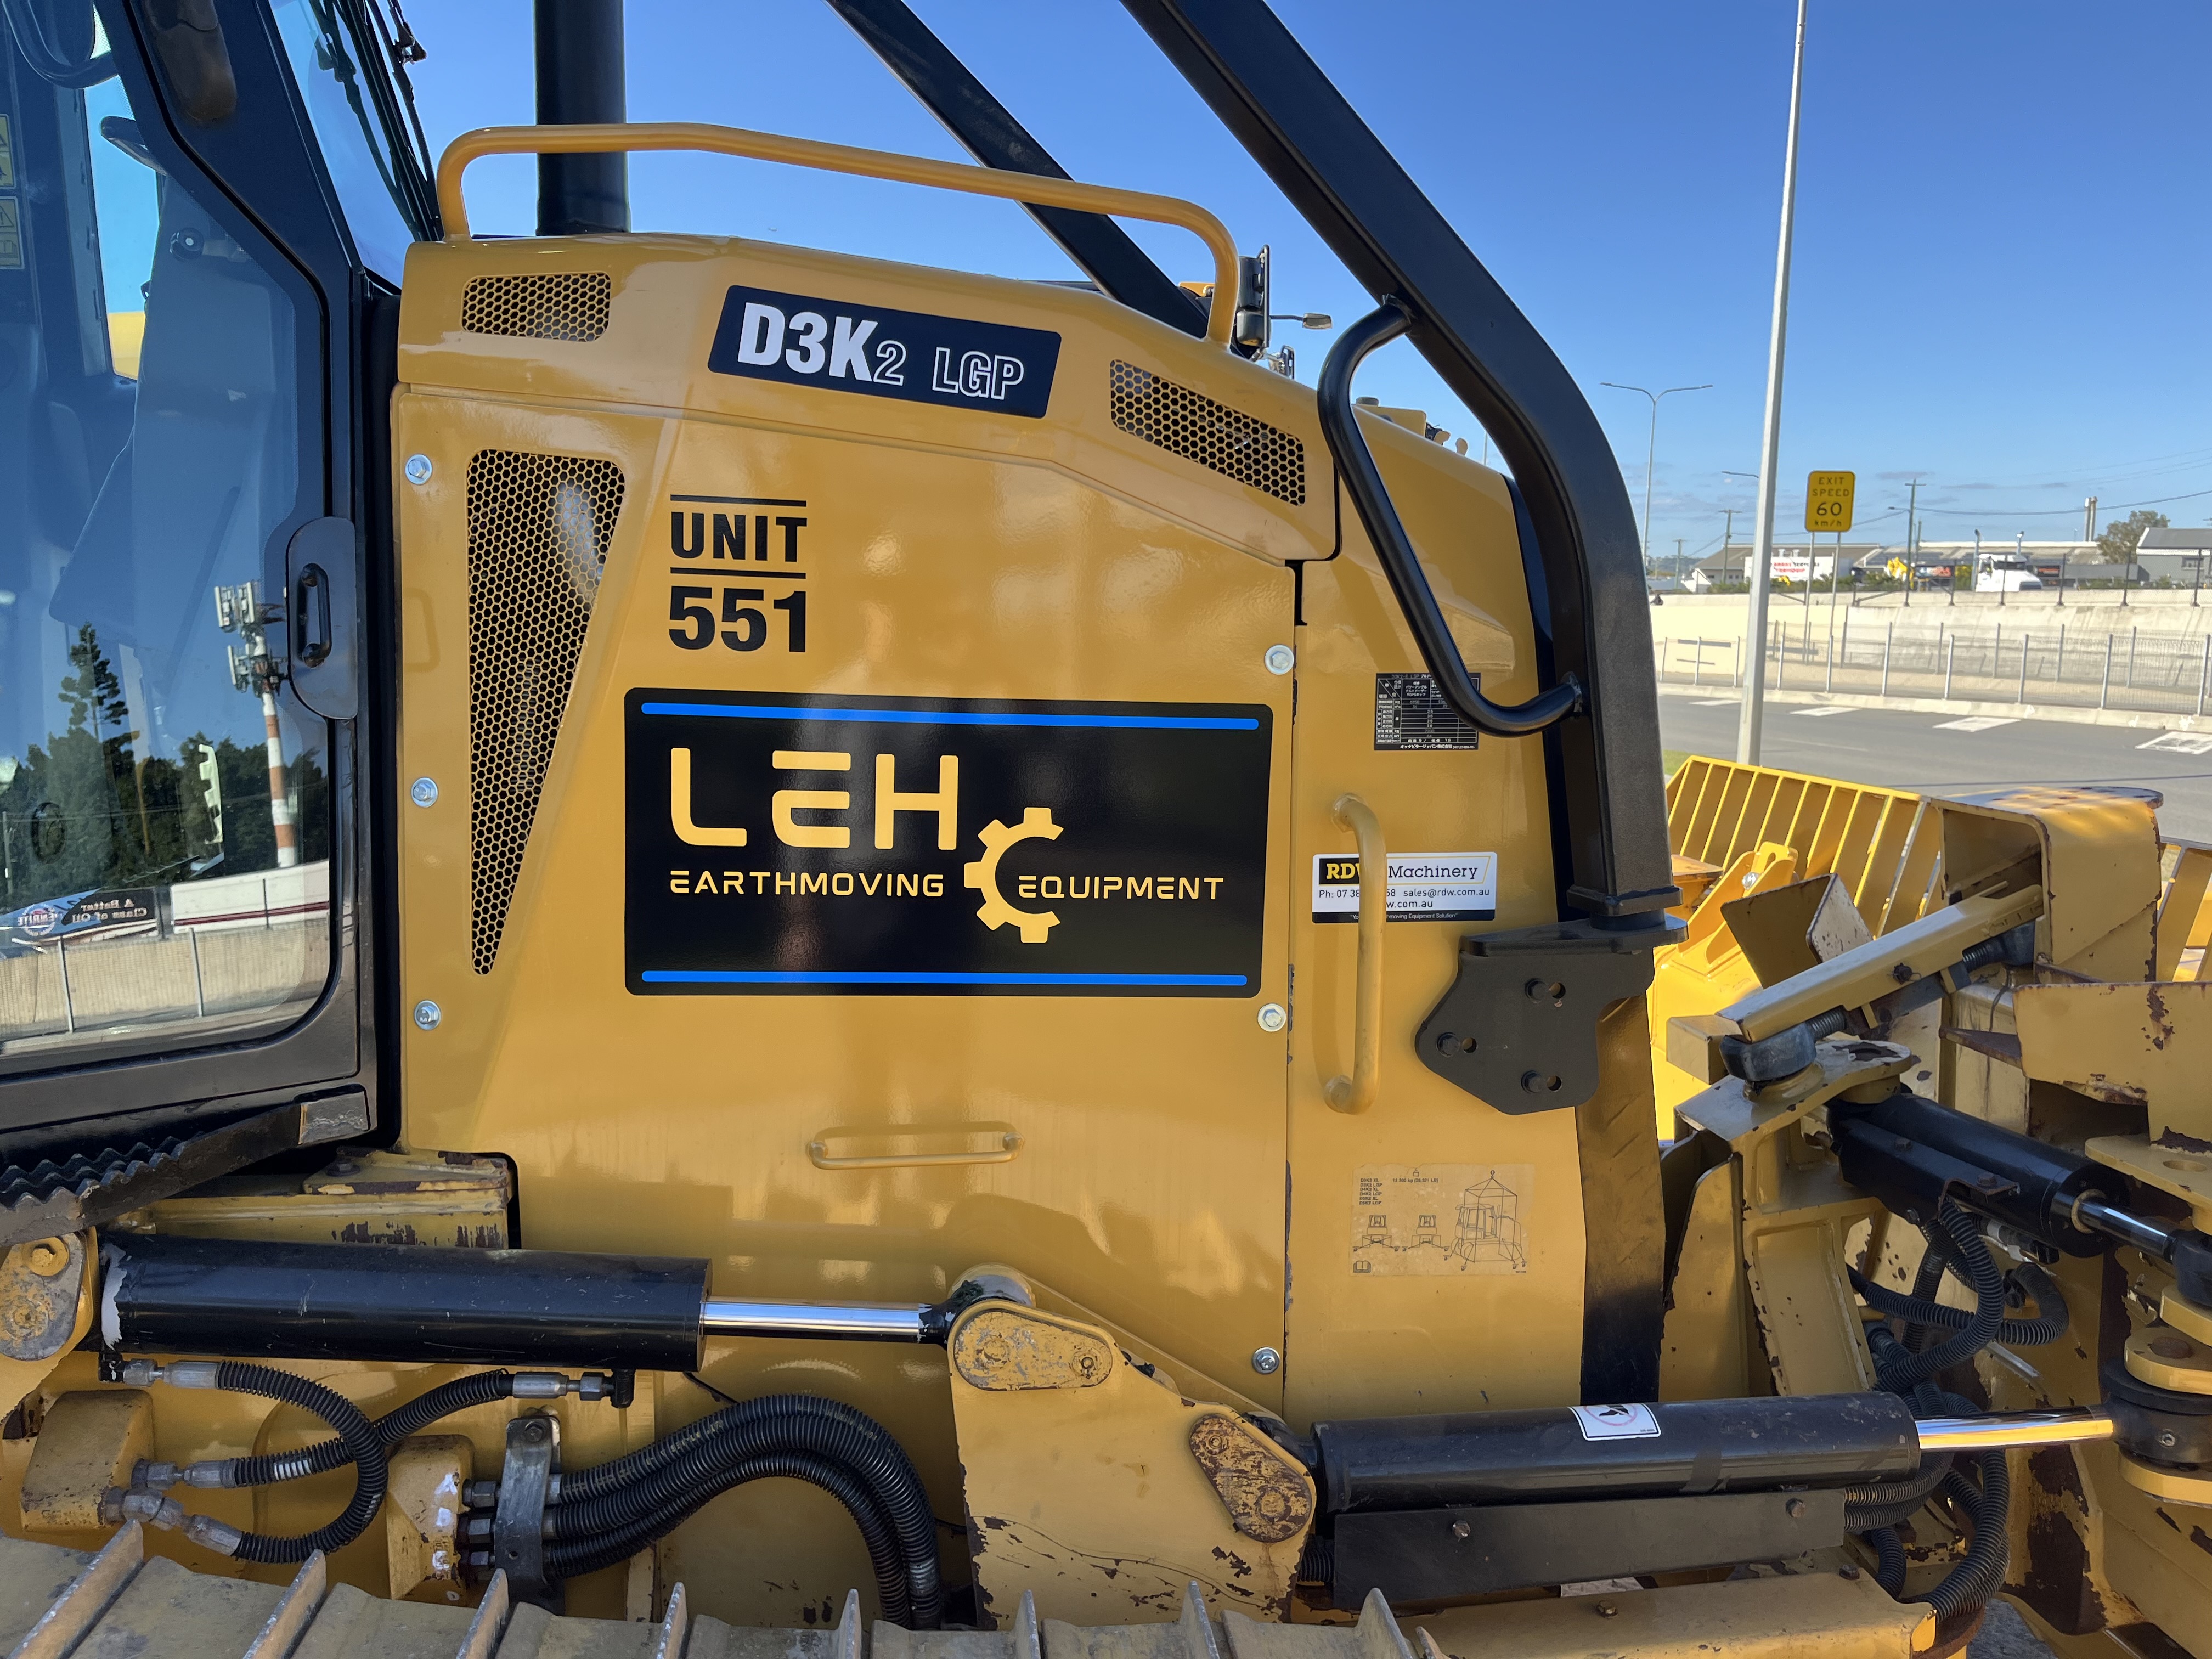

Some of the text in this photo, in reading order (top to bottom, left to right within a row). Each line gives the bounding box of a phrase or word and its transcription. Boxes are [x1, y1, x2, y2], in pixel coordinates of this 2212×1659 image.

[737, 302, 1024, 400] D3K2 LGP
[1813, 489, 1850, 497] SPEED
[1819, 477, 1844, 485] EXIT
[1816, 502, 1842, 516] 60
[671, 511, 808, 562] UNIT
[669, 586, 806, 653] 551
[670, 747, 960, 851] LEH
[670, 869, 1224, 901] EARTHMOVING EQUIPMENT
[1387, 865, 1479, 881] Machinery
[1319, 889, 1333, 899] Ph:
[1336, 889, 1347, 898] 07
[1403, 888, 1489, 898] sales@rdw.com.au
